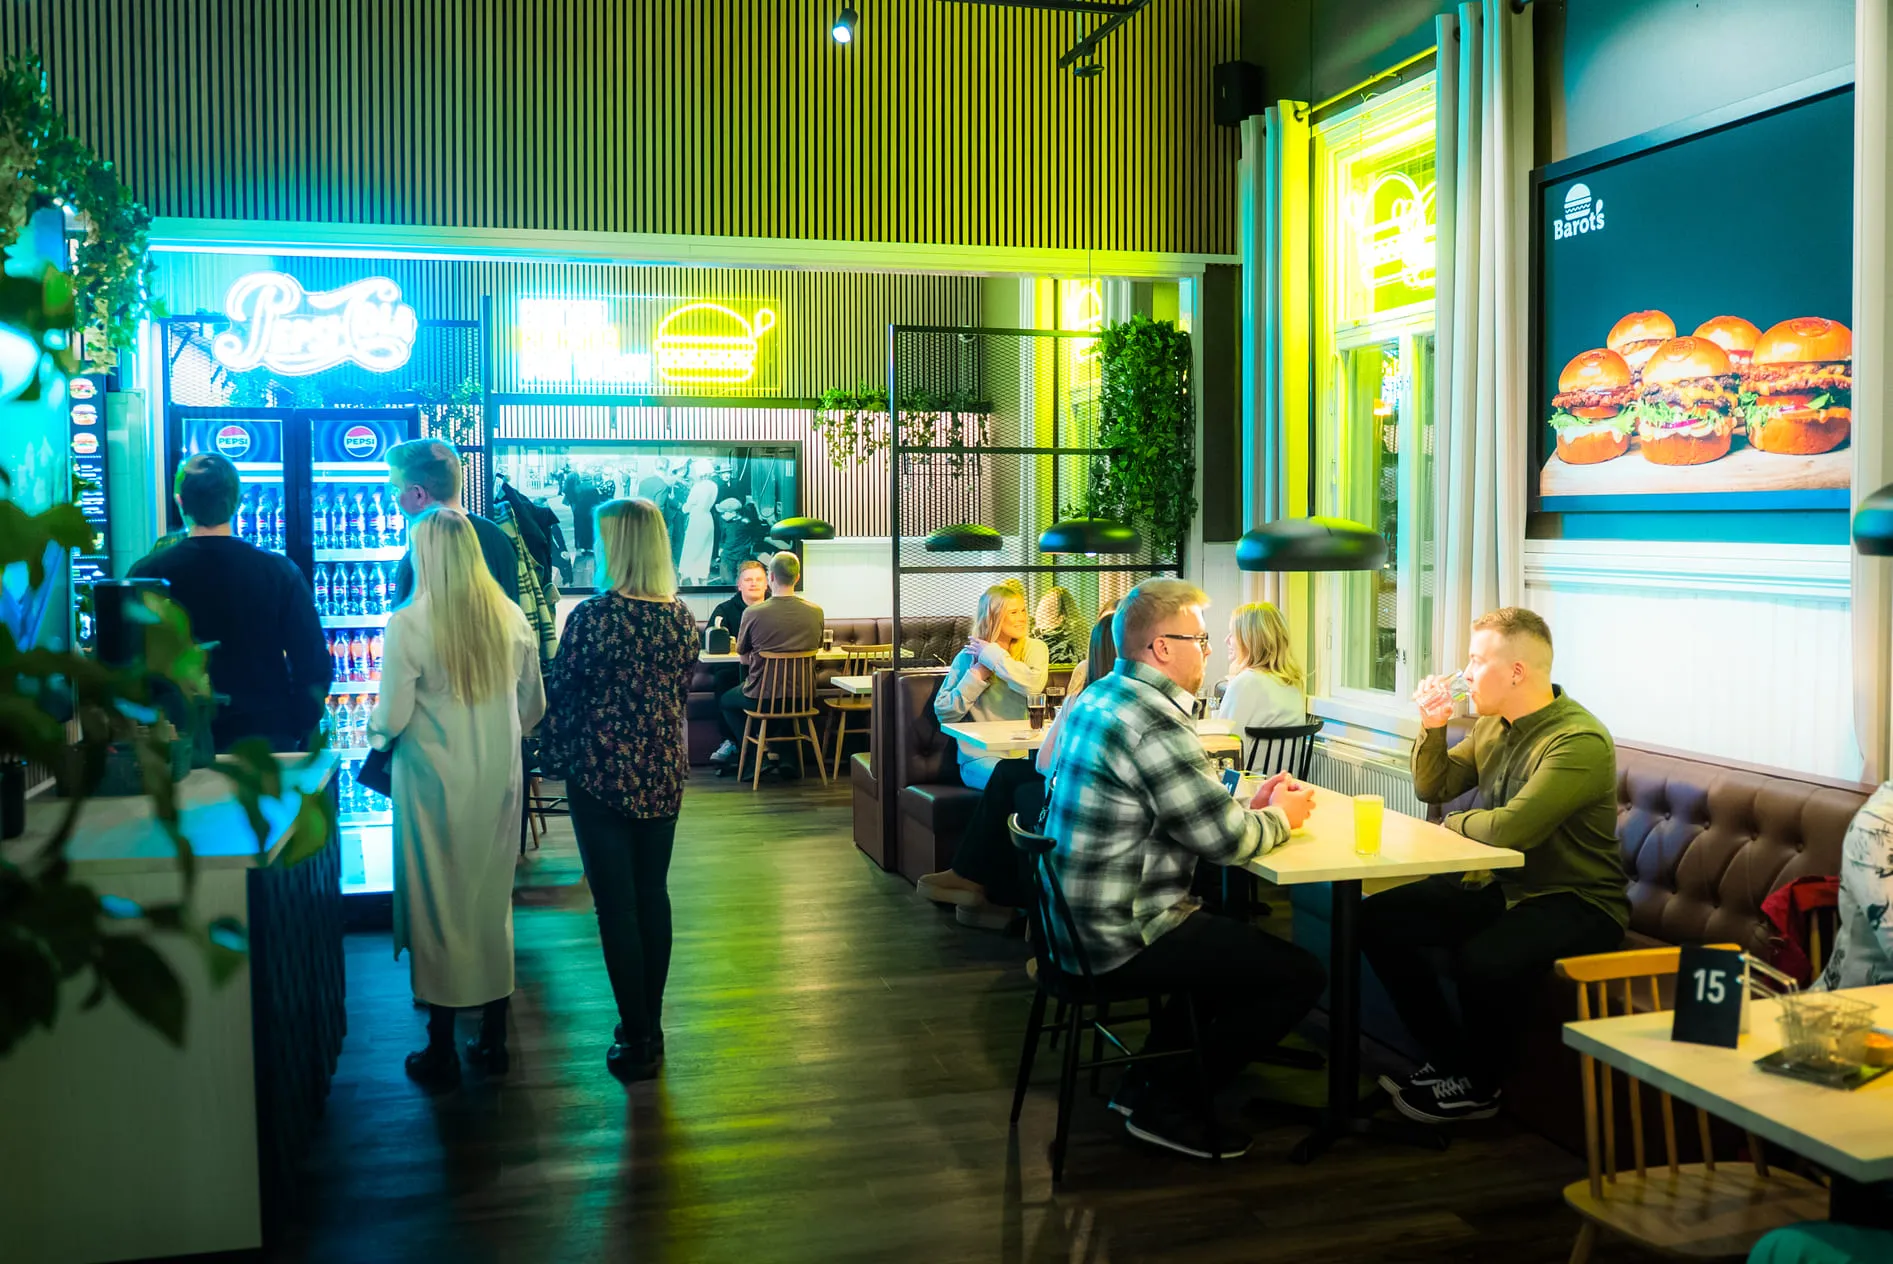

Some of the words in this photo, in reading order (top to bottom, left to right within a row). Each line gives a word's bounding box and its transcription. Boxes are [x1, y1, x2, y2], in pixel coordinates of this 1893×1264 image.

[1553, 198, 1605, 241] Barot's
[218, 437, 248, 446] PEPSI
[346, 437, 375, 446] PEPSI
[1694, 968, 1726, 1004] 15
